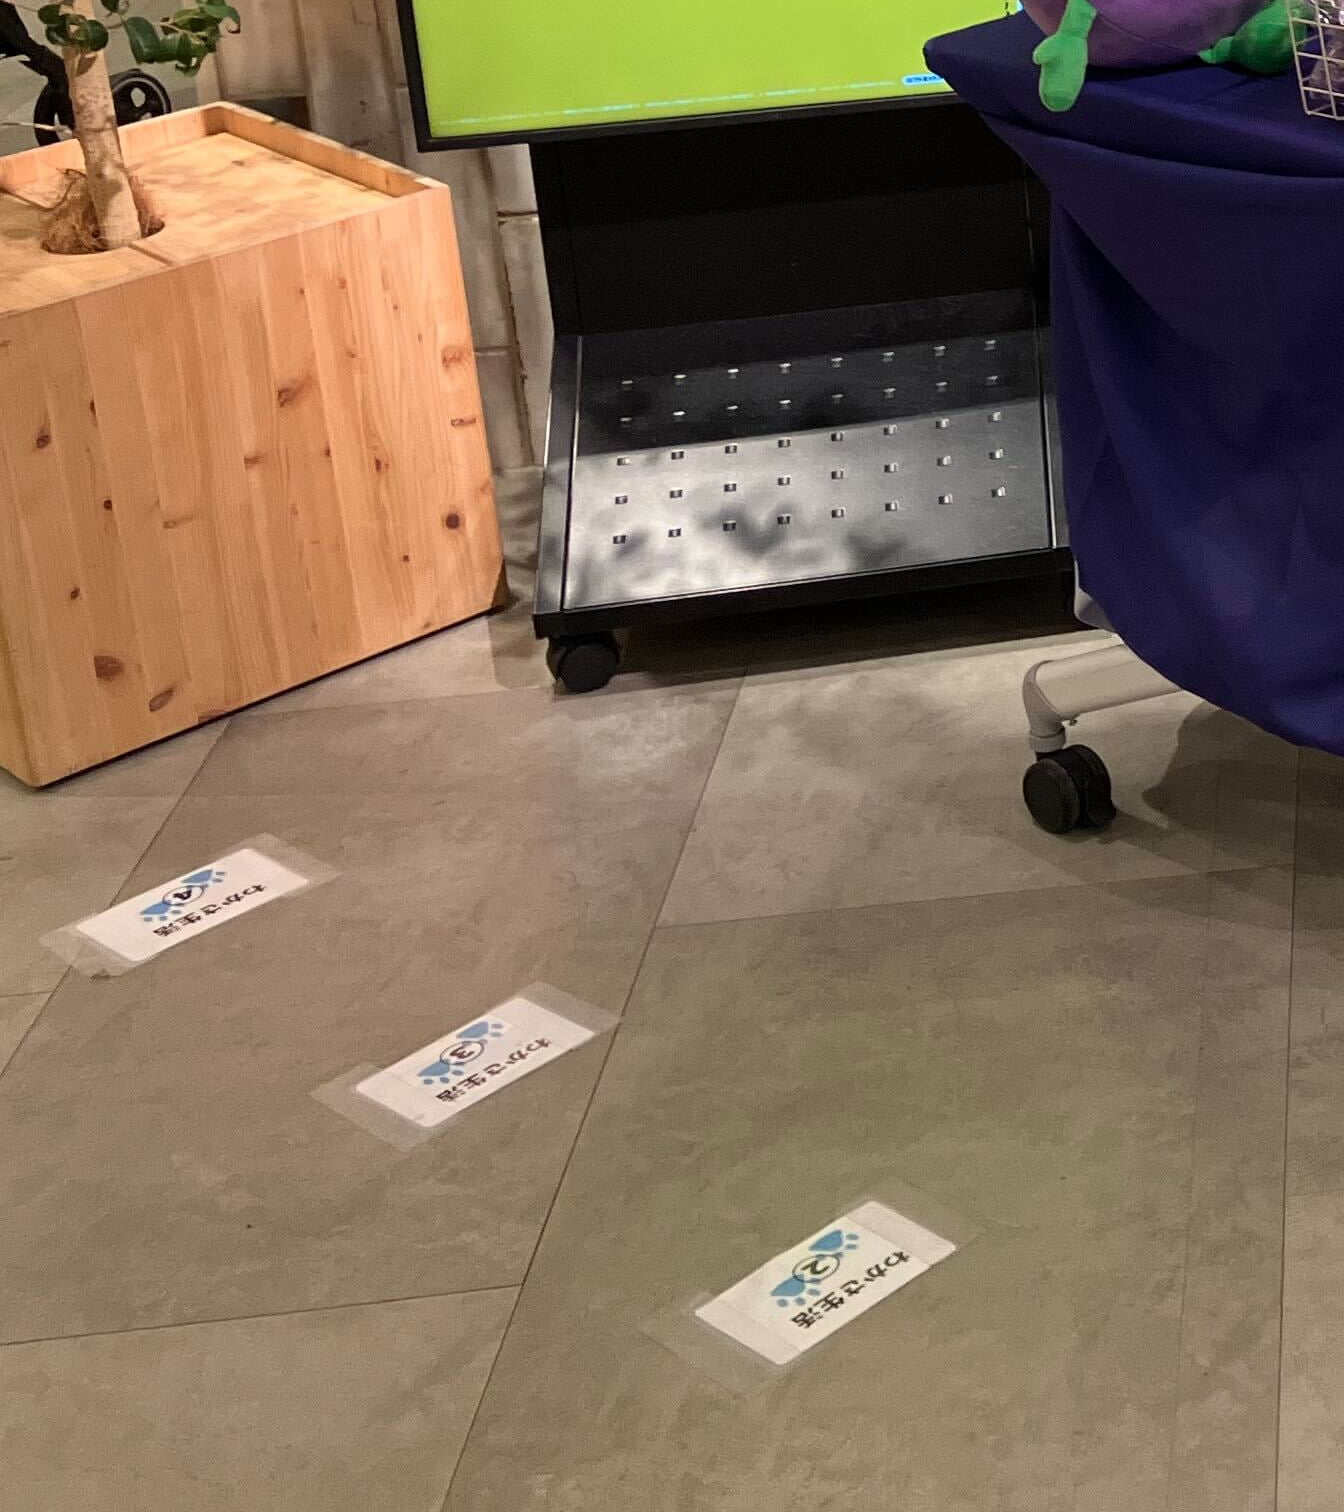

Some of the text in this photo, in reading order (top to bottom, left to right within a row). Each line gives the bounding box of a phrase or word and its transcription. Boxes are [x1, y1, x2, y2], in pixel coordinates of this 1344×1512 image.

[153, 883, 266, 937] わかさ生活
[435, 1038, 552, 1102] わかさ生活
[790, 1250, 912, 1329] わかさ生活
[801, 1260, 829, 1275] 2
